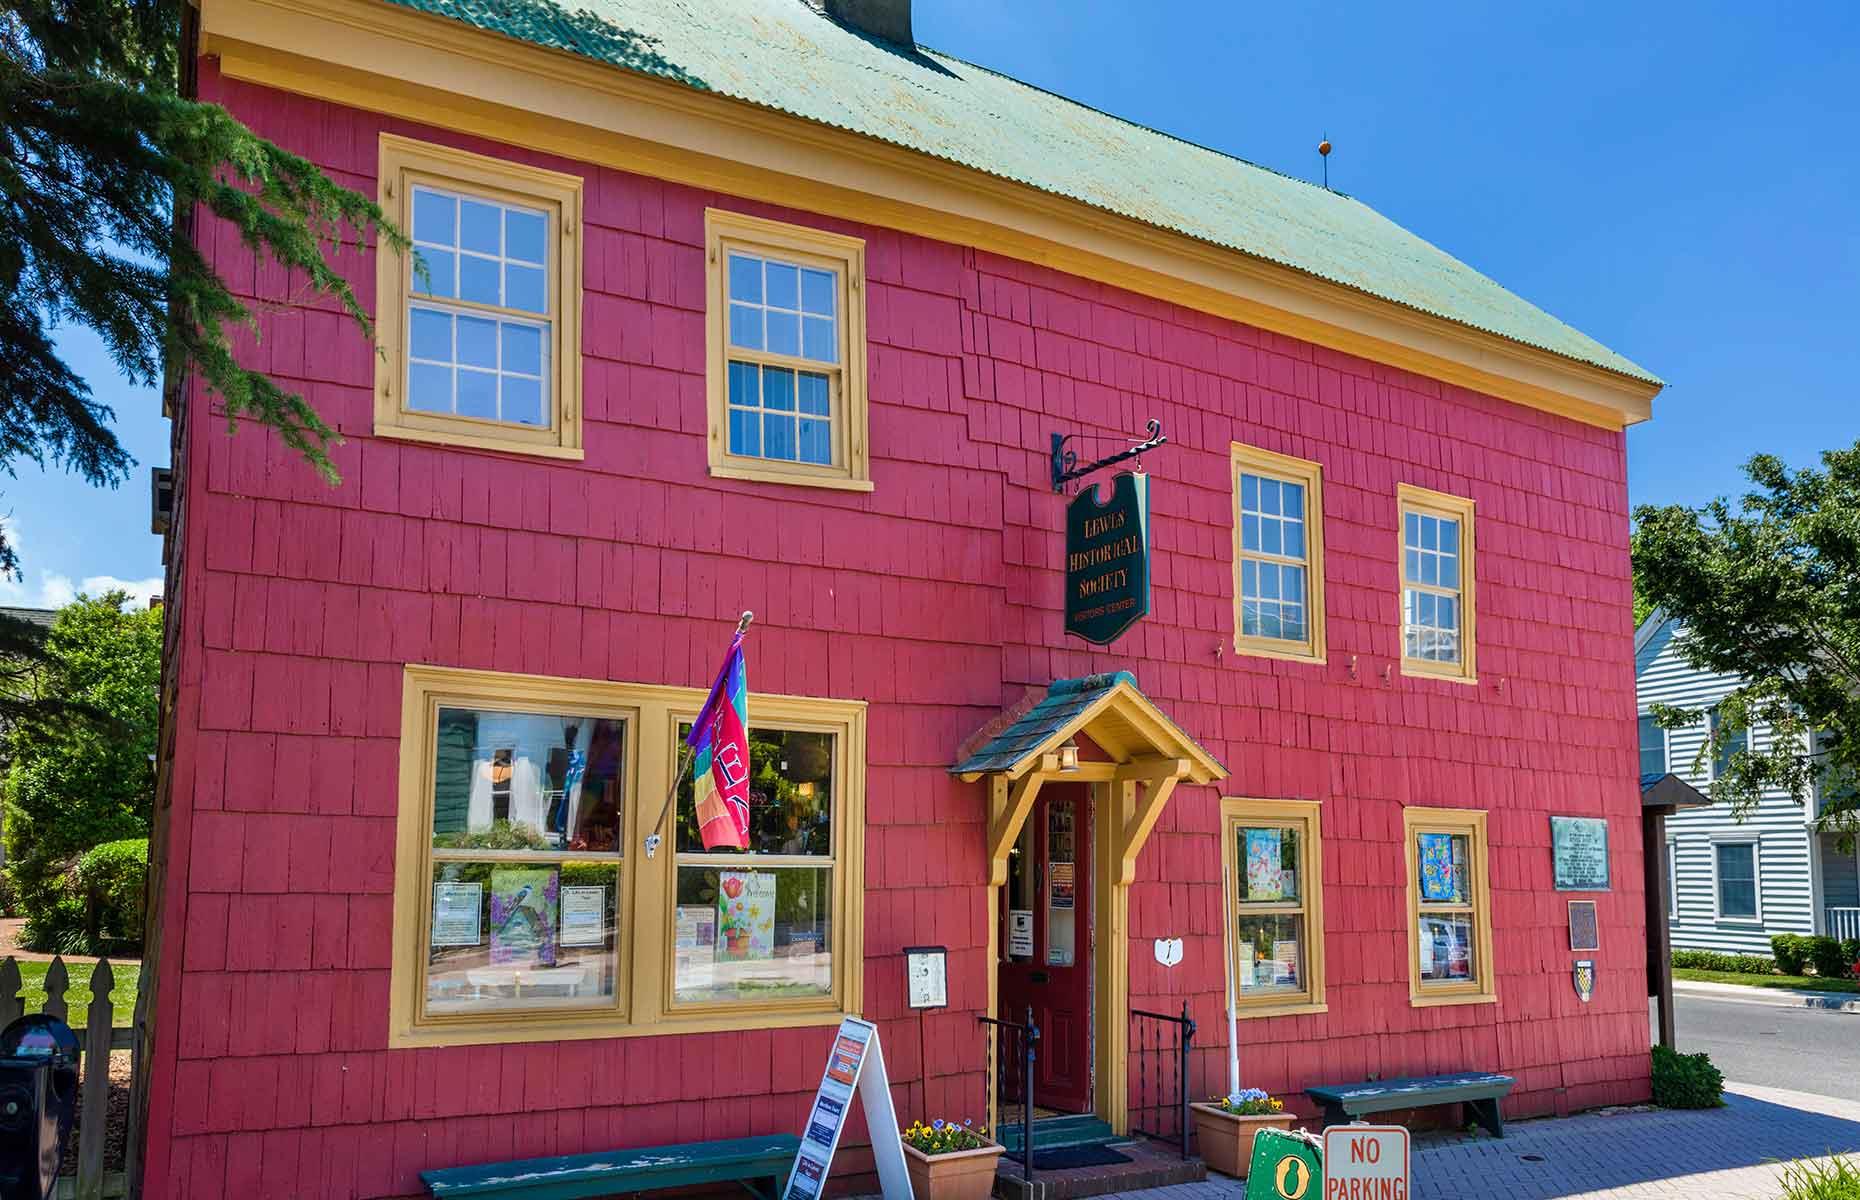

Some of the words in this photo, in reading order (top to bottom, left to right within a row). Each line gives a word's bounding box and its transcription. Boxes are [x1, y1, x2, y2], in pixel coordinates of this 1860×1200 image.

[1085, 511, 1126, 538] LEWES
[1069, 536, 1138, 572] HISTORICAL
[1080, 568, 1128, 598] SOCIETY
[1351, 1138, 1380, 1163] NO
[1329, 1177, 1404, 1200] PARKING
